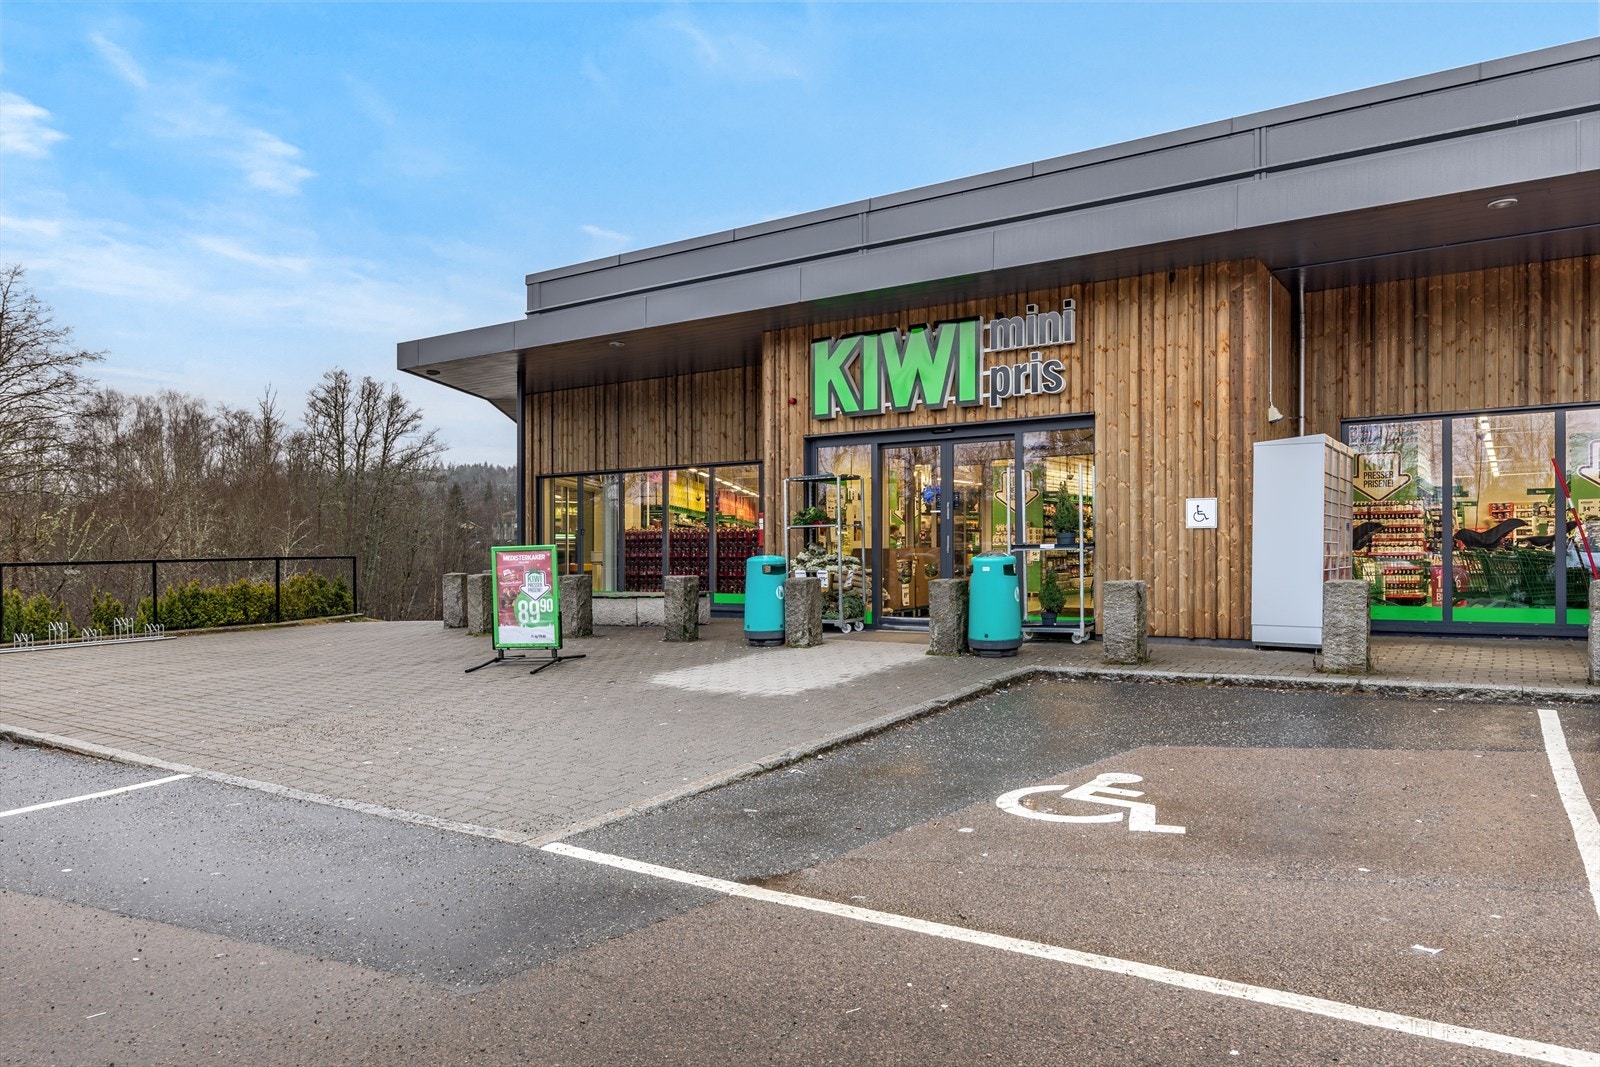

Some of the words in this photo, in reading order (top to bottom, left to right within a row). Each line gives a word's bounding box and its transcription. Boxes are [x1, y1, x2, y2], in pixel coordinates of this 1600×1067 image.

[989, 299, 1076, 352] mini
[811, 316, 984, 420] KIWI
[989, 351, 1066, 408] pris
[1363, 471, 1394, 479] PRESSER
[1363, 480, 1394, 488] PRISENE!
[528, 575, 542, 583] KIWI
[518, 600, 540, 624] 89
[541, 598, 553, 612] 90
